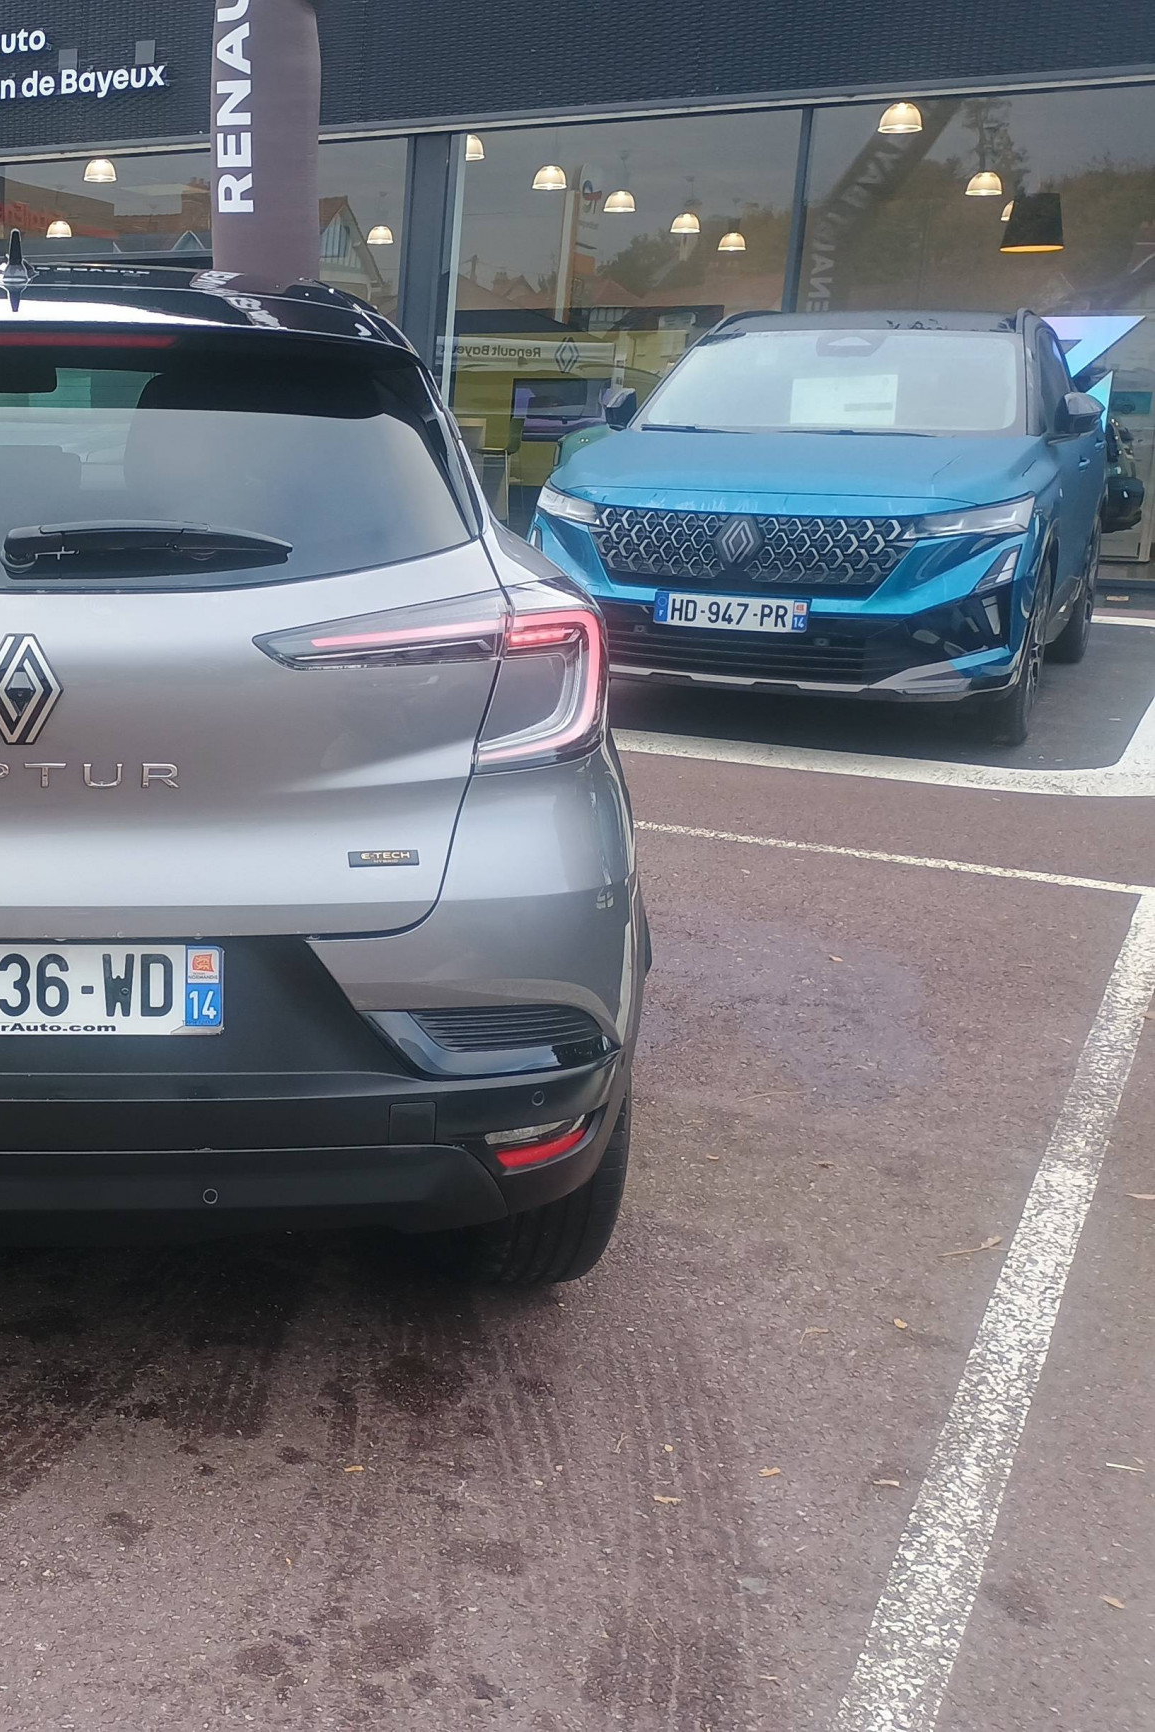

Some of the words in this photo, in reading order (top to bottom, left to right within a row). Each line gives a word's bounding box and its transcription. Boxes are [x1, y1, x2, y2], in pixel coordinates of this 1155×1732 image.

[21, 70, 55, 98] de
[60, 64, 166, 98] Bayeux
[658, 609, 665, 617] F
[669, 598, 789, 628] HD-947-PR
[793, 616, 805, 629] 14
[189, 990, 218, 1020] 14
